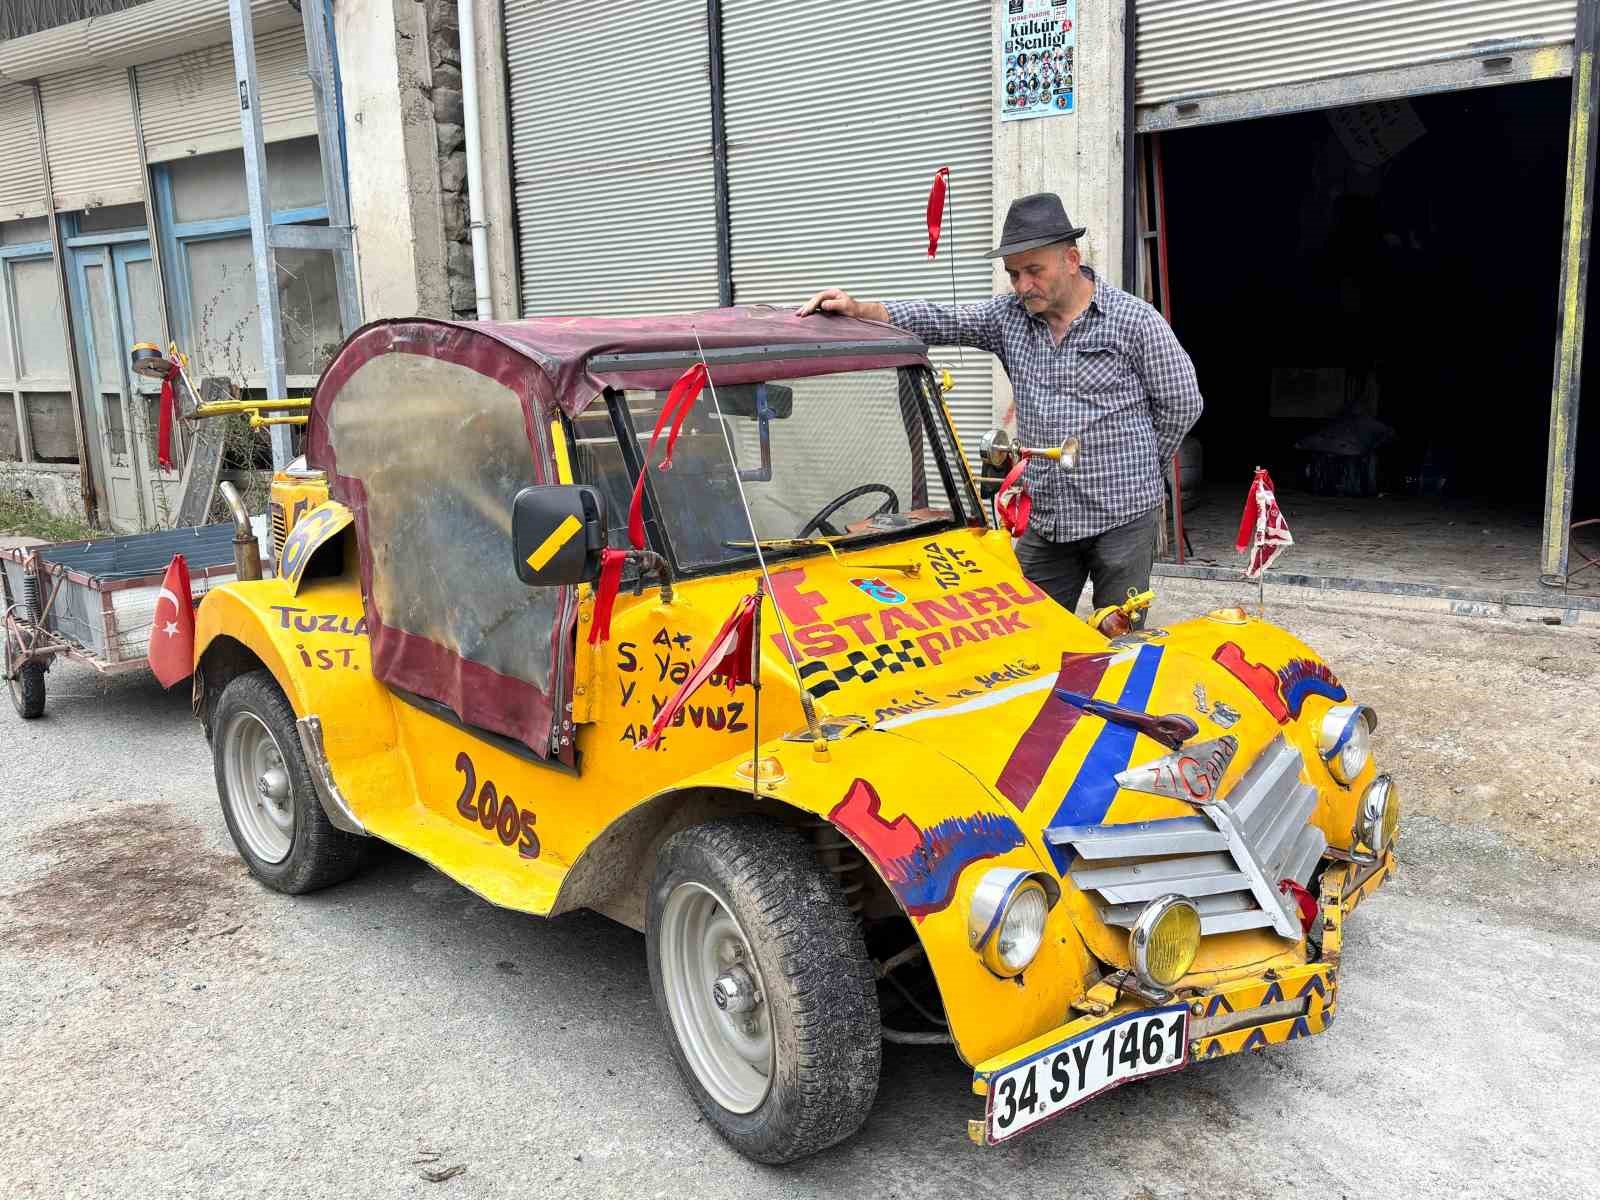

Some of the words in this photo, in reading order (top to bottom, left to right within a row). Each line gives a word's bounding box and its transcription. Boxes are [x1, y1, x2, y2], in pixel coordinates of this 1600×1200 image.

[1010, 18, 1059, 38] Kültür
[270, 605, 370, 636] TUZLA
[917, 611, 1032, 666] PARK
[617, 641, 644, 673] S.
[455, 751, 541, 860] 2005
[997, 1064, 1039, 1129] 34
[1050, 1039, 1095, 1104] SY
[1102, 1013, 1186, 1077] 1461
